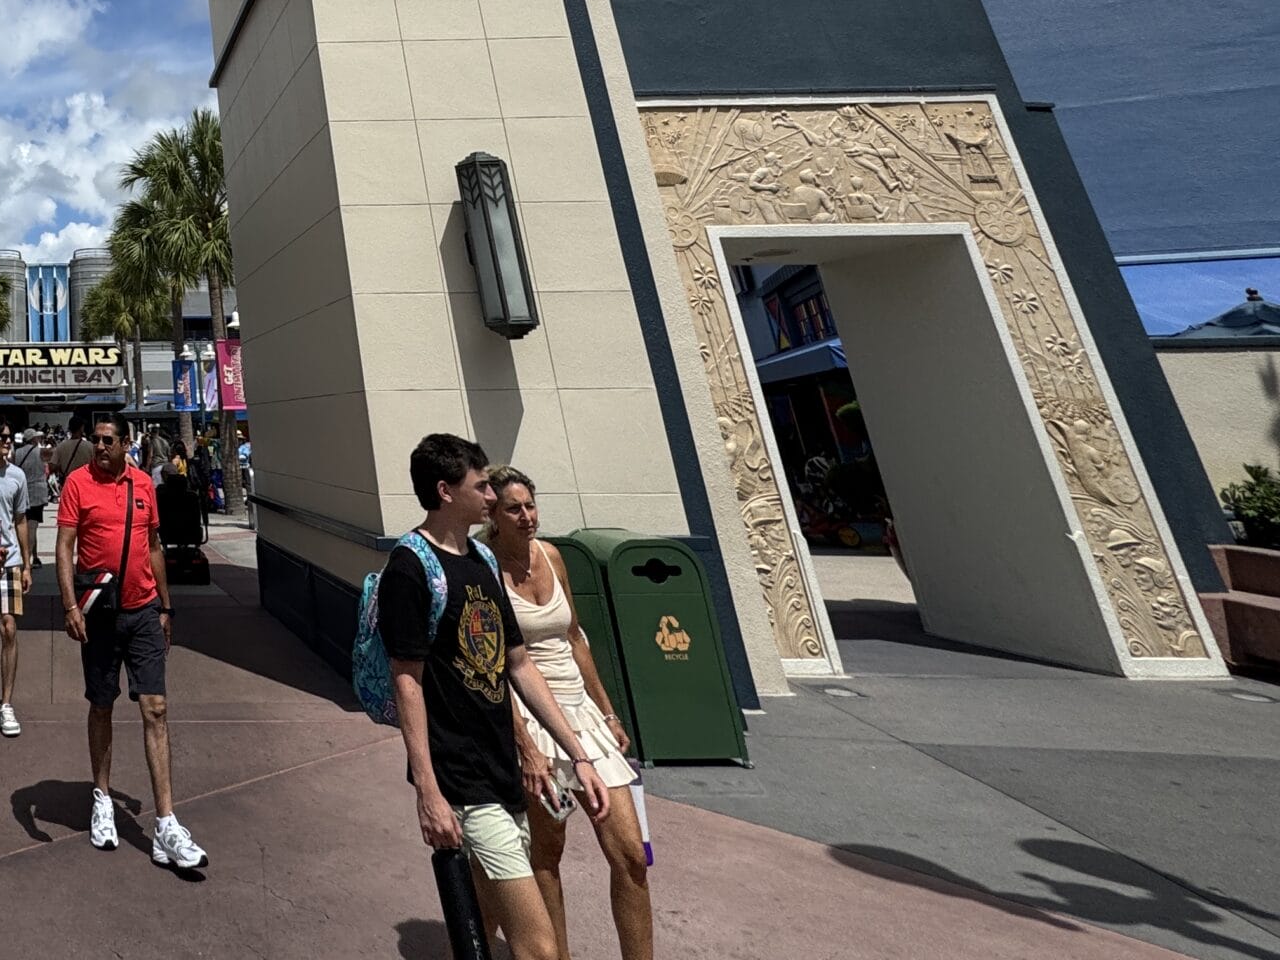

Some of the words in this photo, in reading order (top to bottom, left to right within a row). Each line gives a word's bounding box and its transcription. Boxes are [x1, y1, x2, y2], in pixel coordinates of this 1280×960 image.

[49, 347, 121, 366] WARS
[72, 369, 115, 384] BAY
[223, 364, 234, 385] GET
